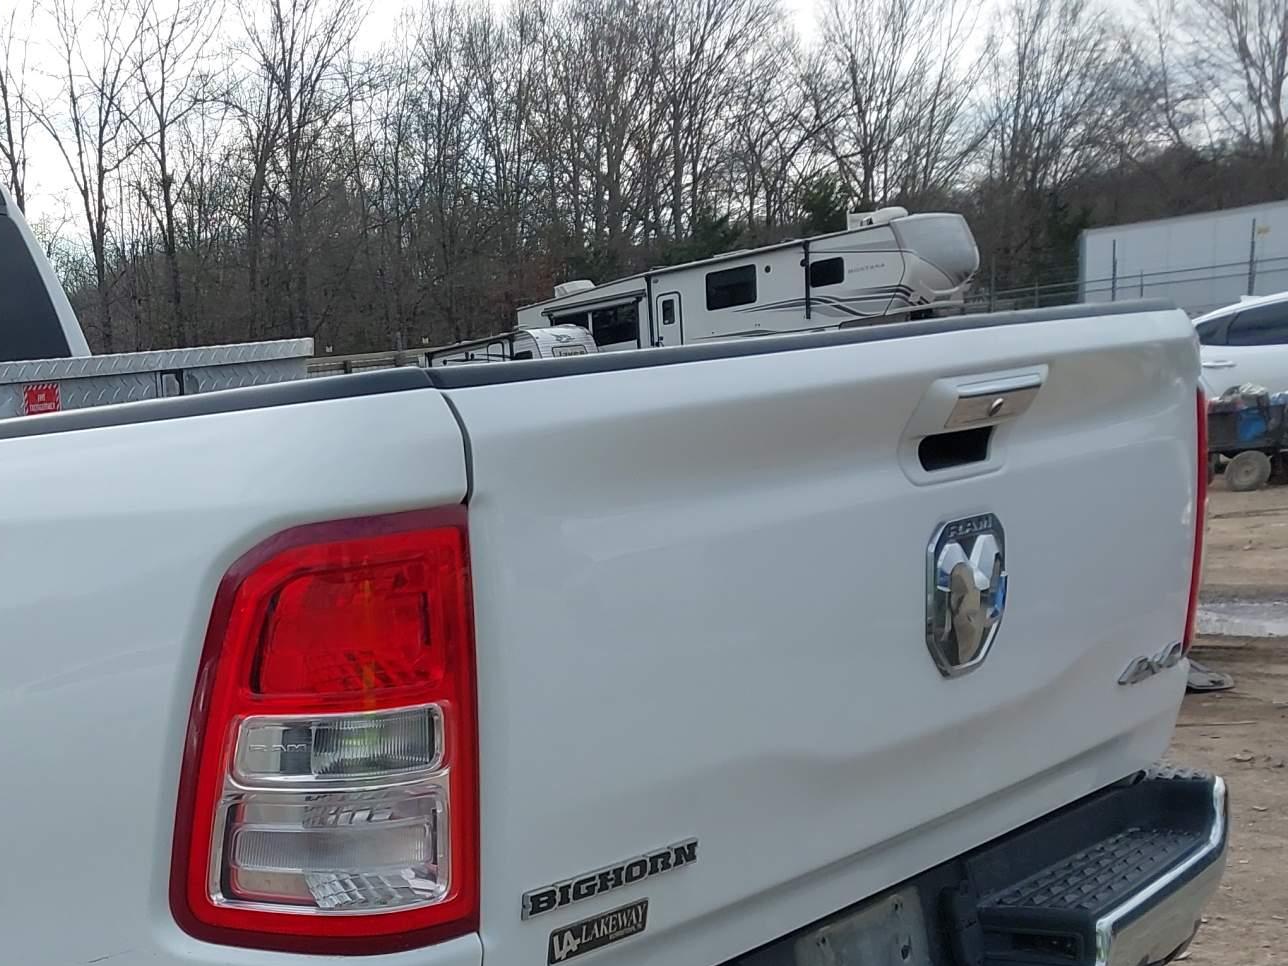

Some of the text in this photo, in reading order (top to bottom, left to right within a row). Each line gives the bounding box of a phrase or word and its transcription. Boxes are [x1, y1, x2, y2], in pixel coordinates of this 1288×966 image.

[948, 515, 993, 538] RAM
[525, 839, 699, 917] BIGHORN
[581, 903, 648, 944] LAKEWAY
